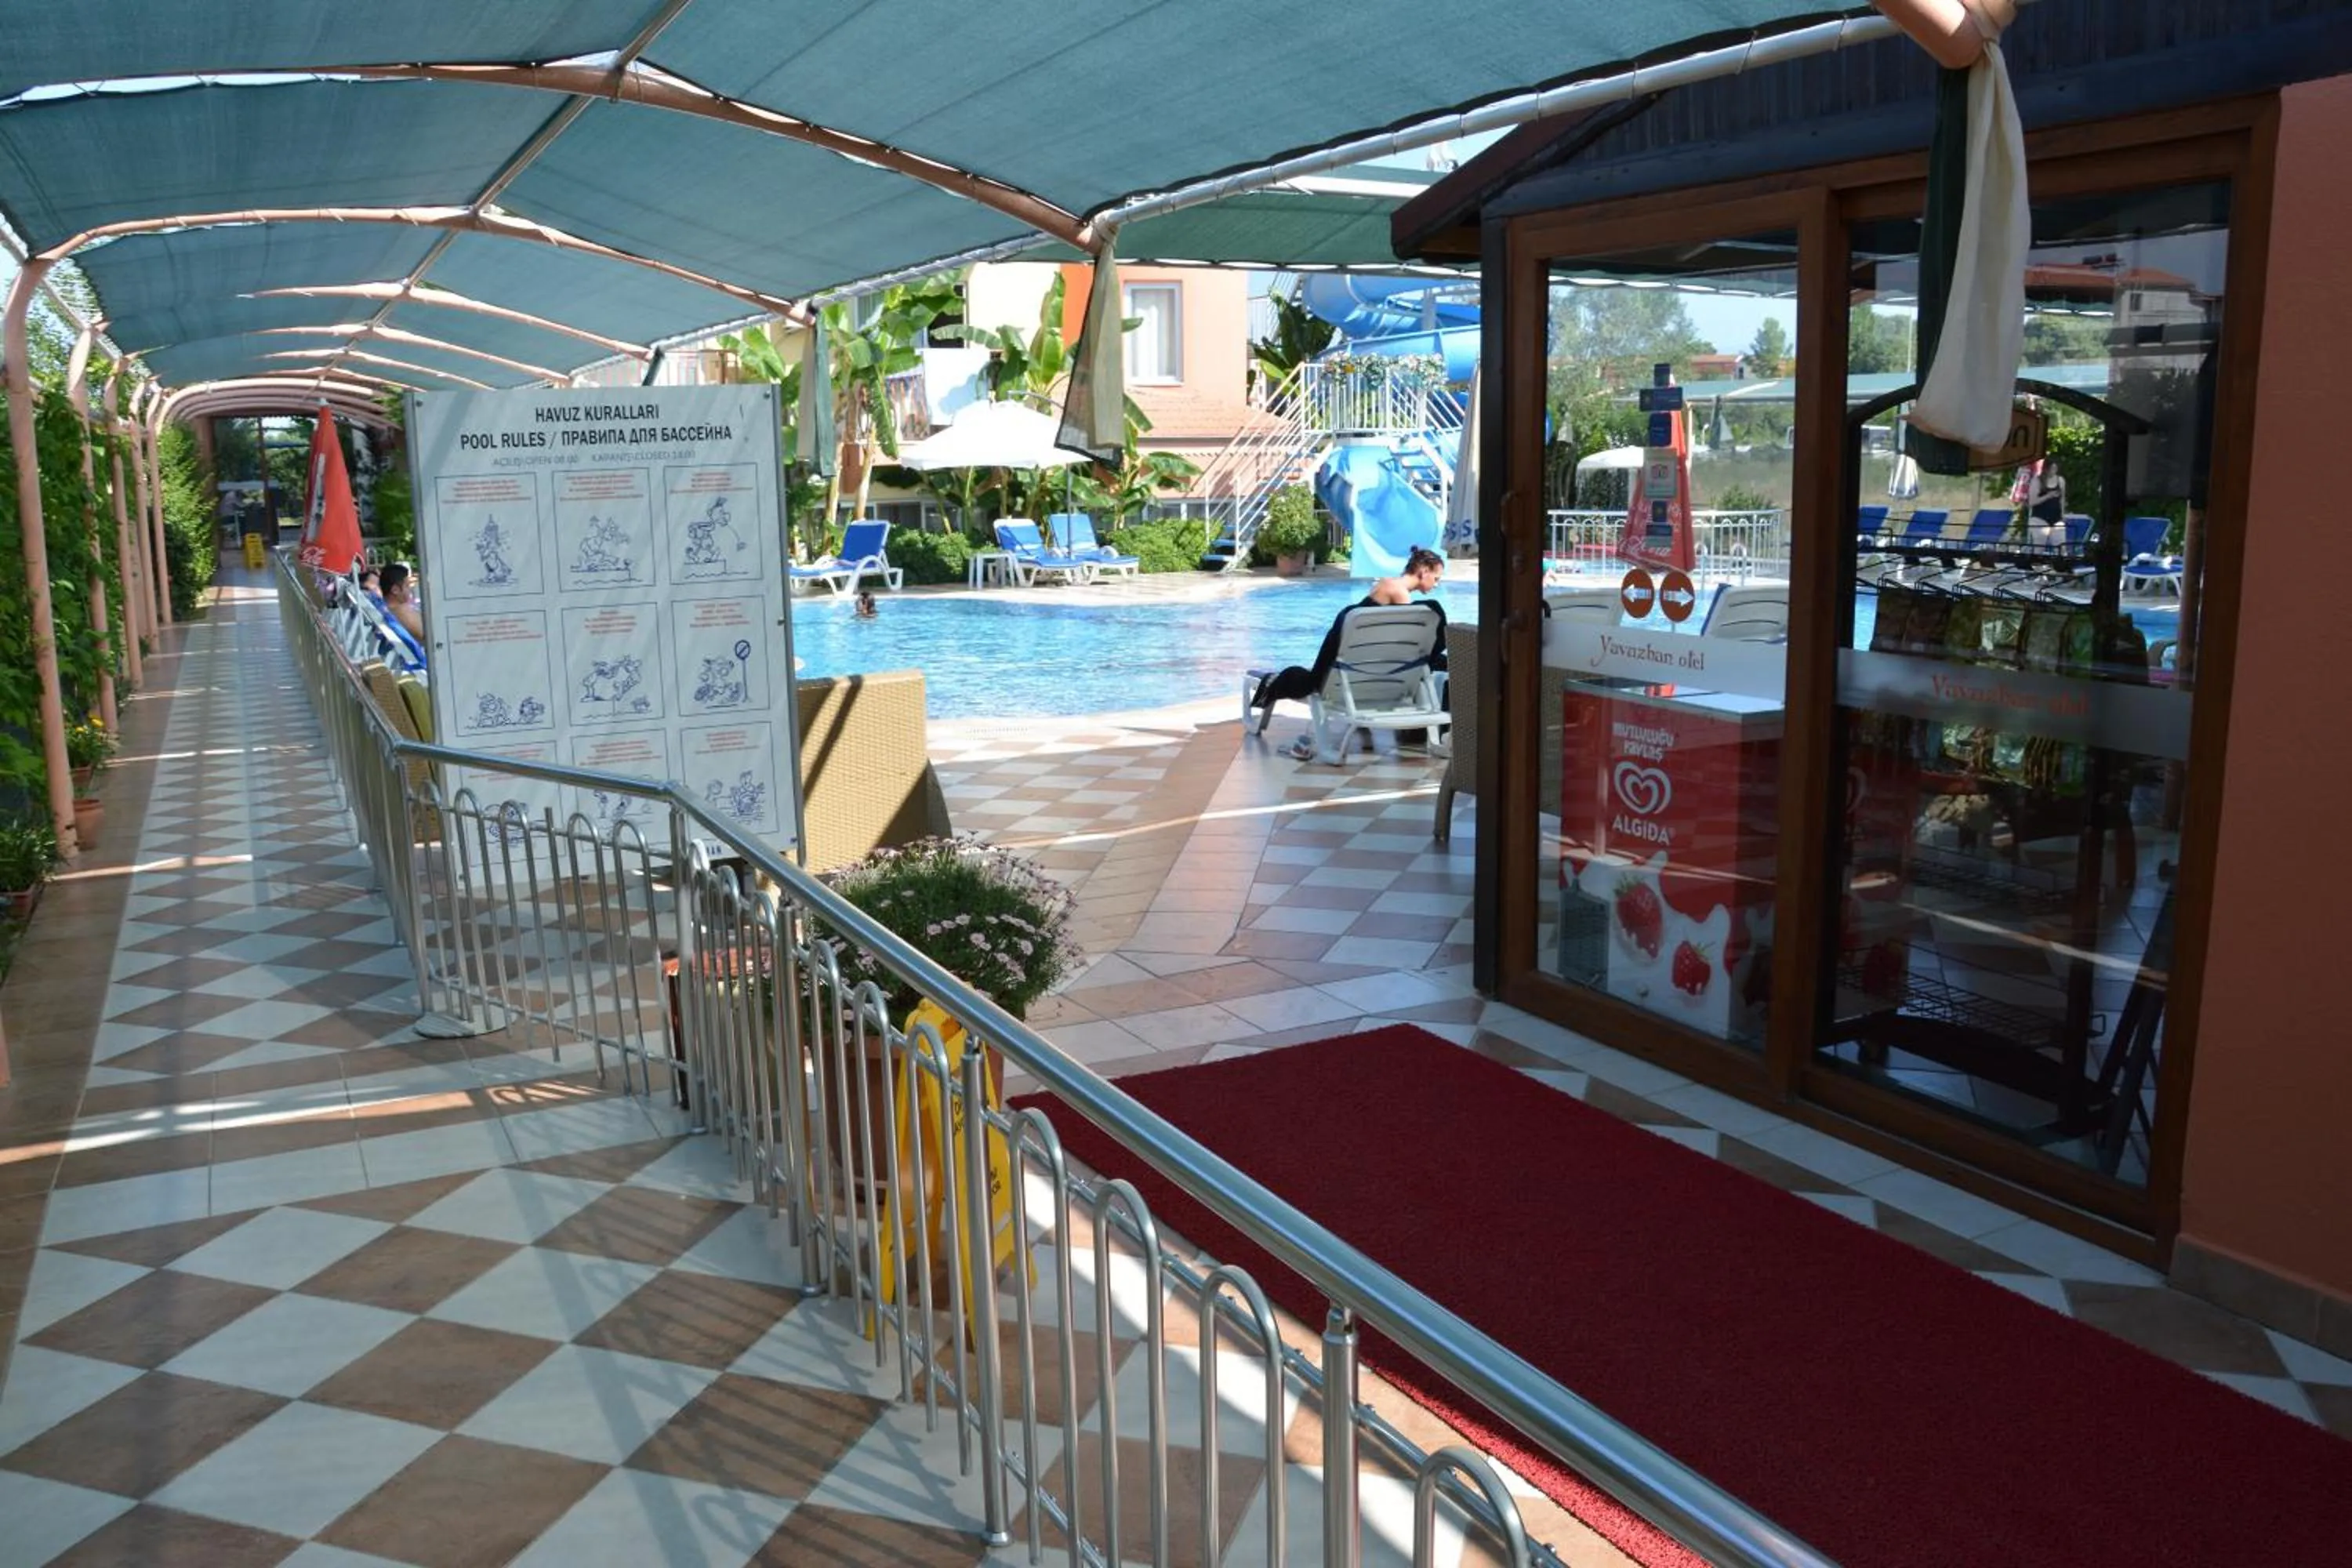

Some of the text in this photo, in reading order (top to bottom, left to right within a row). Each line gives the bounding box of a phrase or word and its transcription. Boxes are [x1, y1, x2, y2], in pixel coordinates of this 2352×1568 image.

[535, 405, 660, 423] HAVUZ KURALLARI
[460, 433, 498, 450] POOL
[501, 431, 546, 448] RULES
[661, 422, 732, 442] БАССЕЙНА
[1612, 814, 1670, 846] ALGIDA
